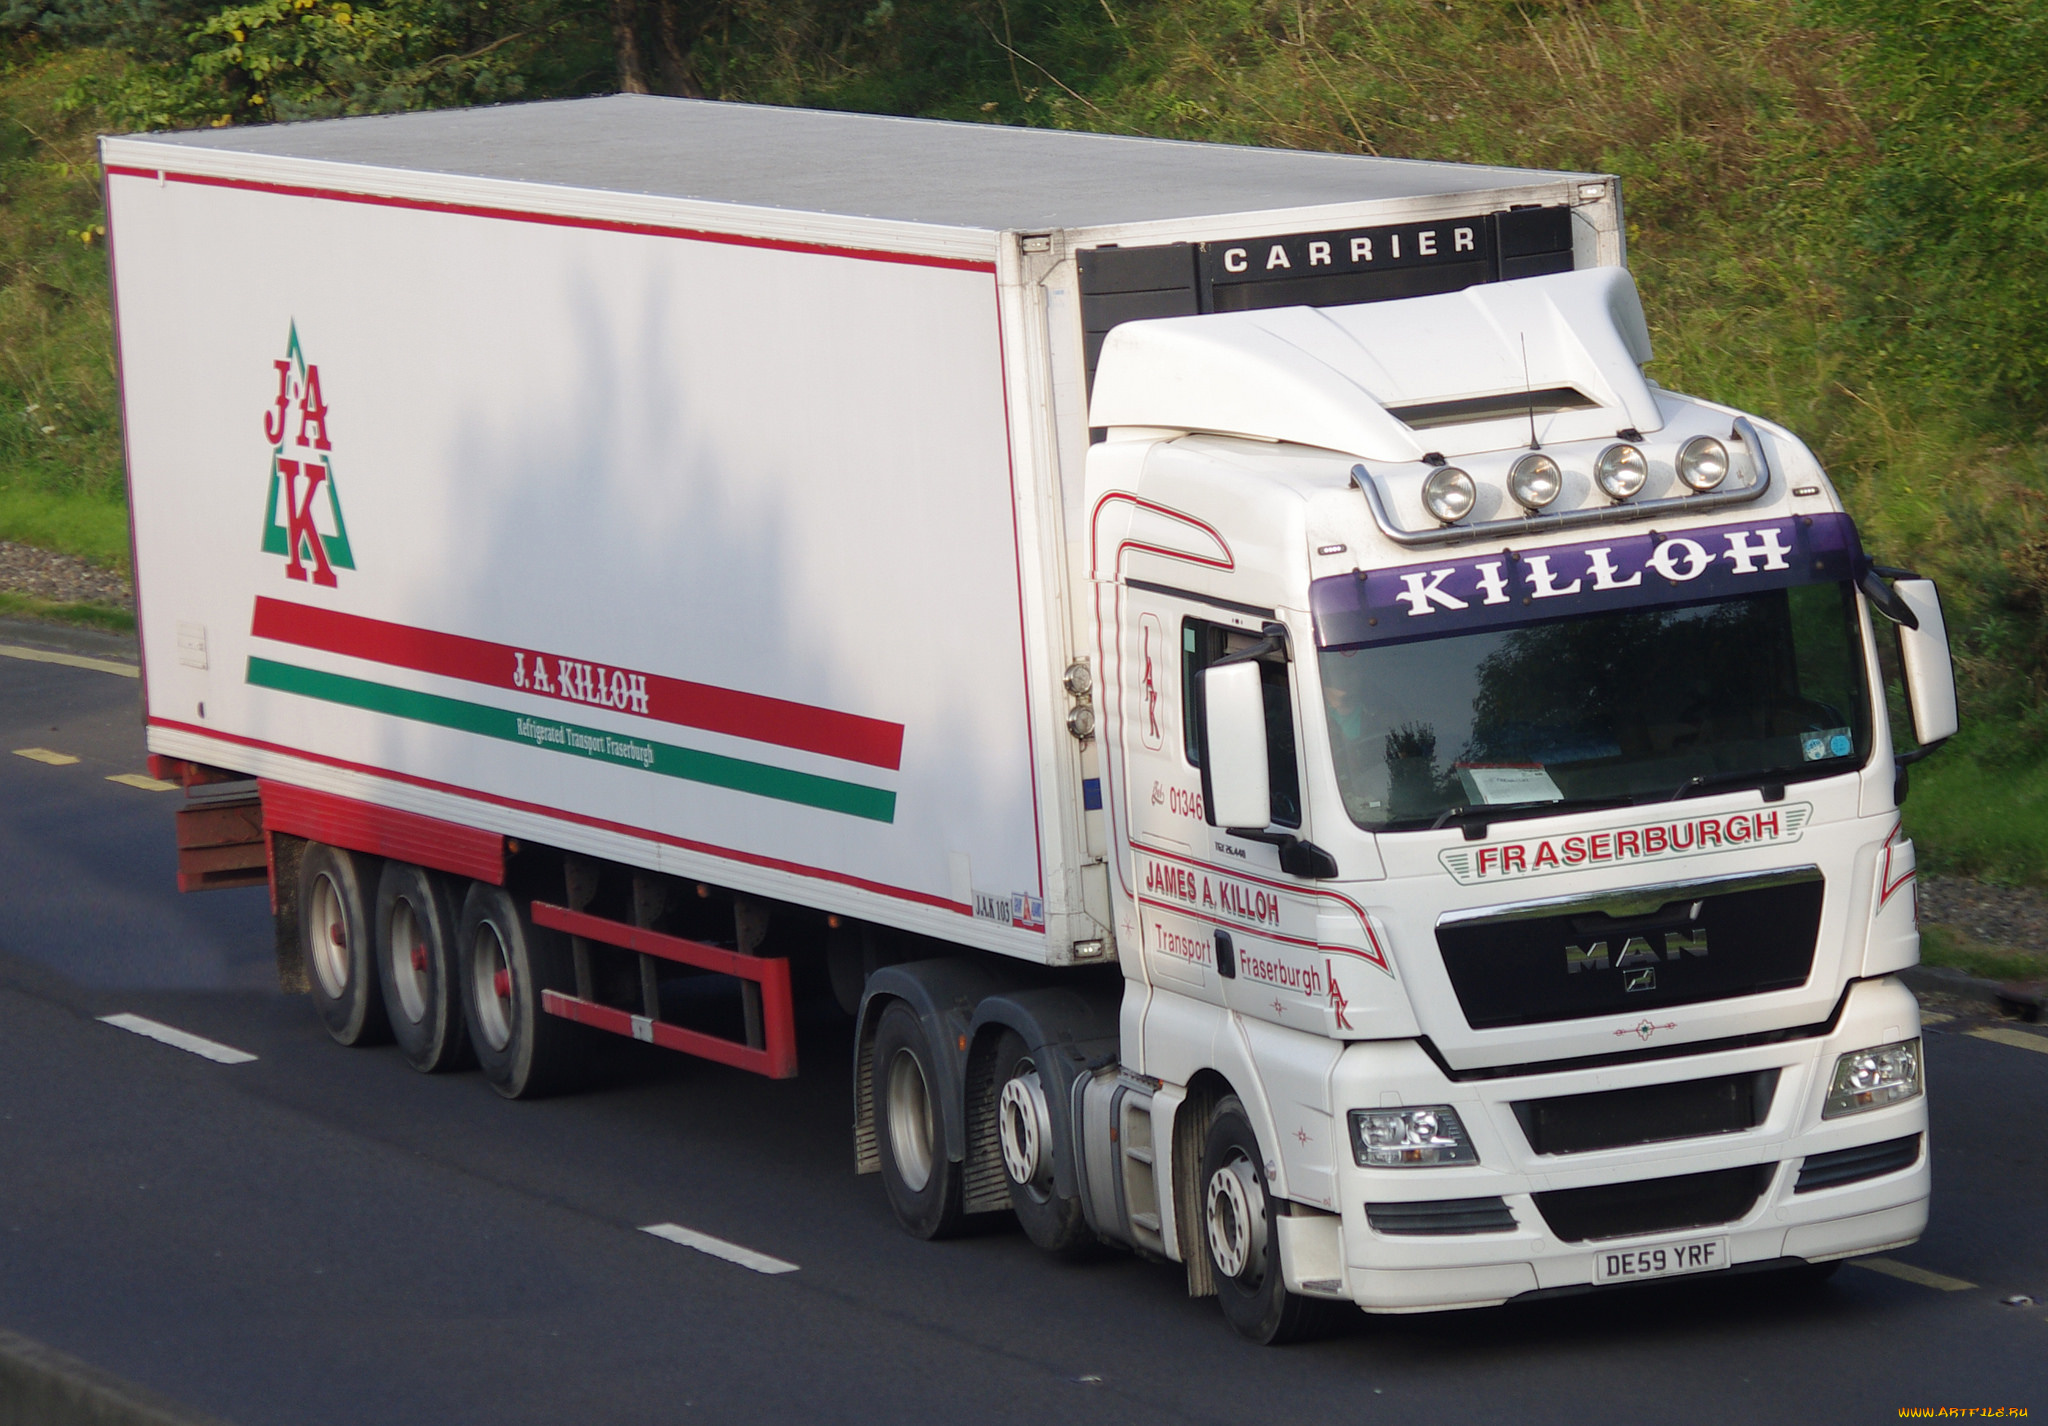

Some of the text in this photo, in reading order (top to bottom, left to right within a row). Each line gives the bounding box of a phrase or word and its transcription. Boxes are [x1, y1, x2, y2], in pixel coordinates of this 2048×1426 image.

[1223, 226, 1475, 273] CARRIER
[1395, 528, 1792, 616] KILLOH
[557, 659, 649, 714] KILLOH
[516, 717, 655, 768] Refrigerated Transport Fraserburgh
[1169, 786, 1203, 821] 01346
[1477, 811, 1780, 878] FRASERBURGH
[996, 901, 1010, 923] 103
[1146, 861, 1197, 903] JAMES
[1219, 880, 1280, 927] KILLOH
[1155, 923, 1322, 997] Transport Fraserburgh
[1565, 928, 1709, 974] MAN
[1607, 1242, 1716, 1276] DE59 YRF
